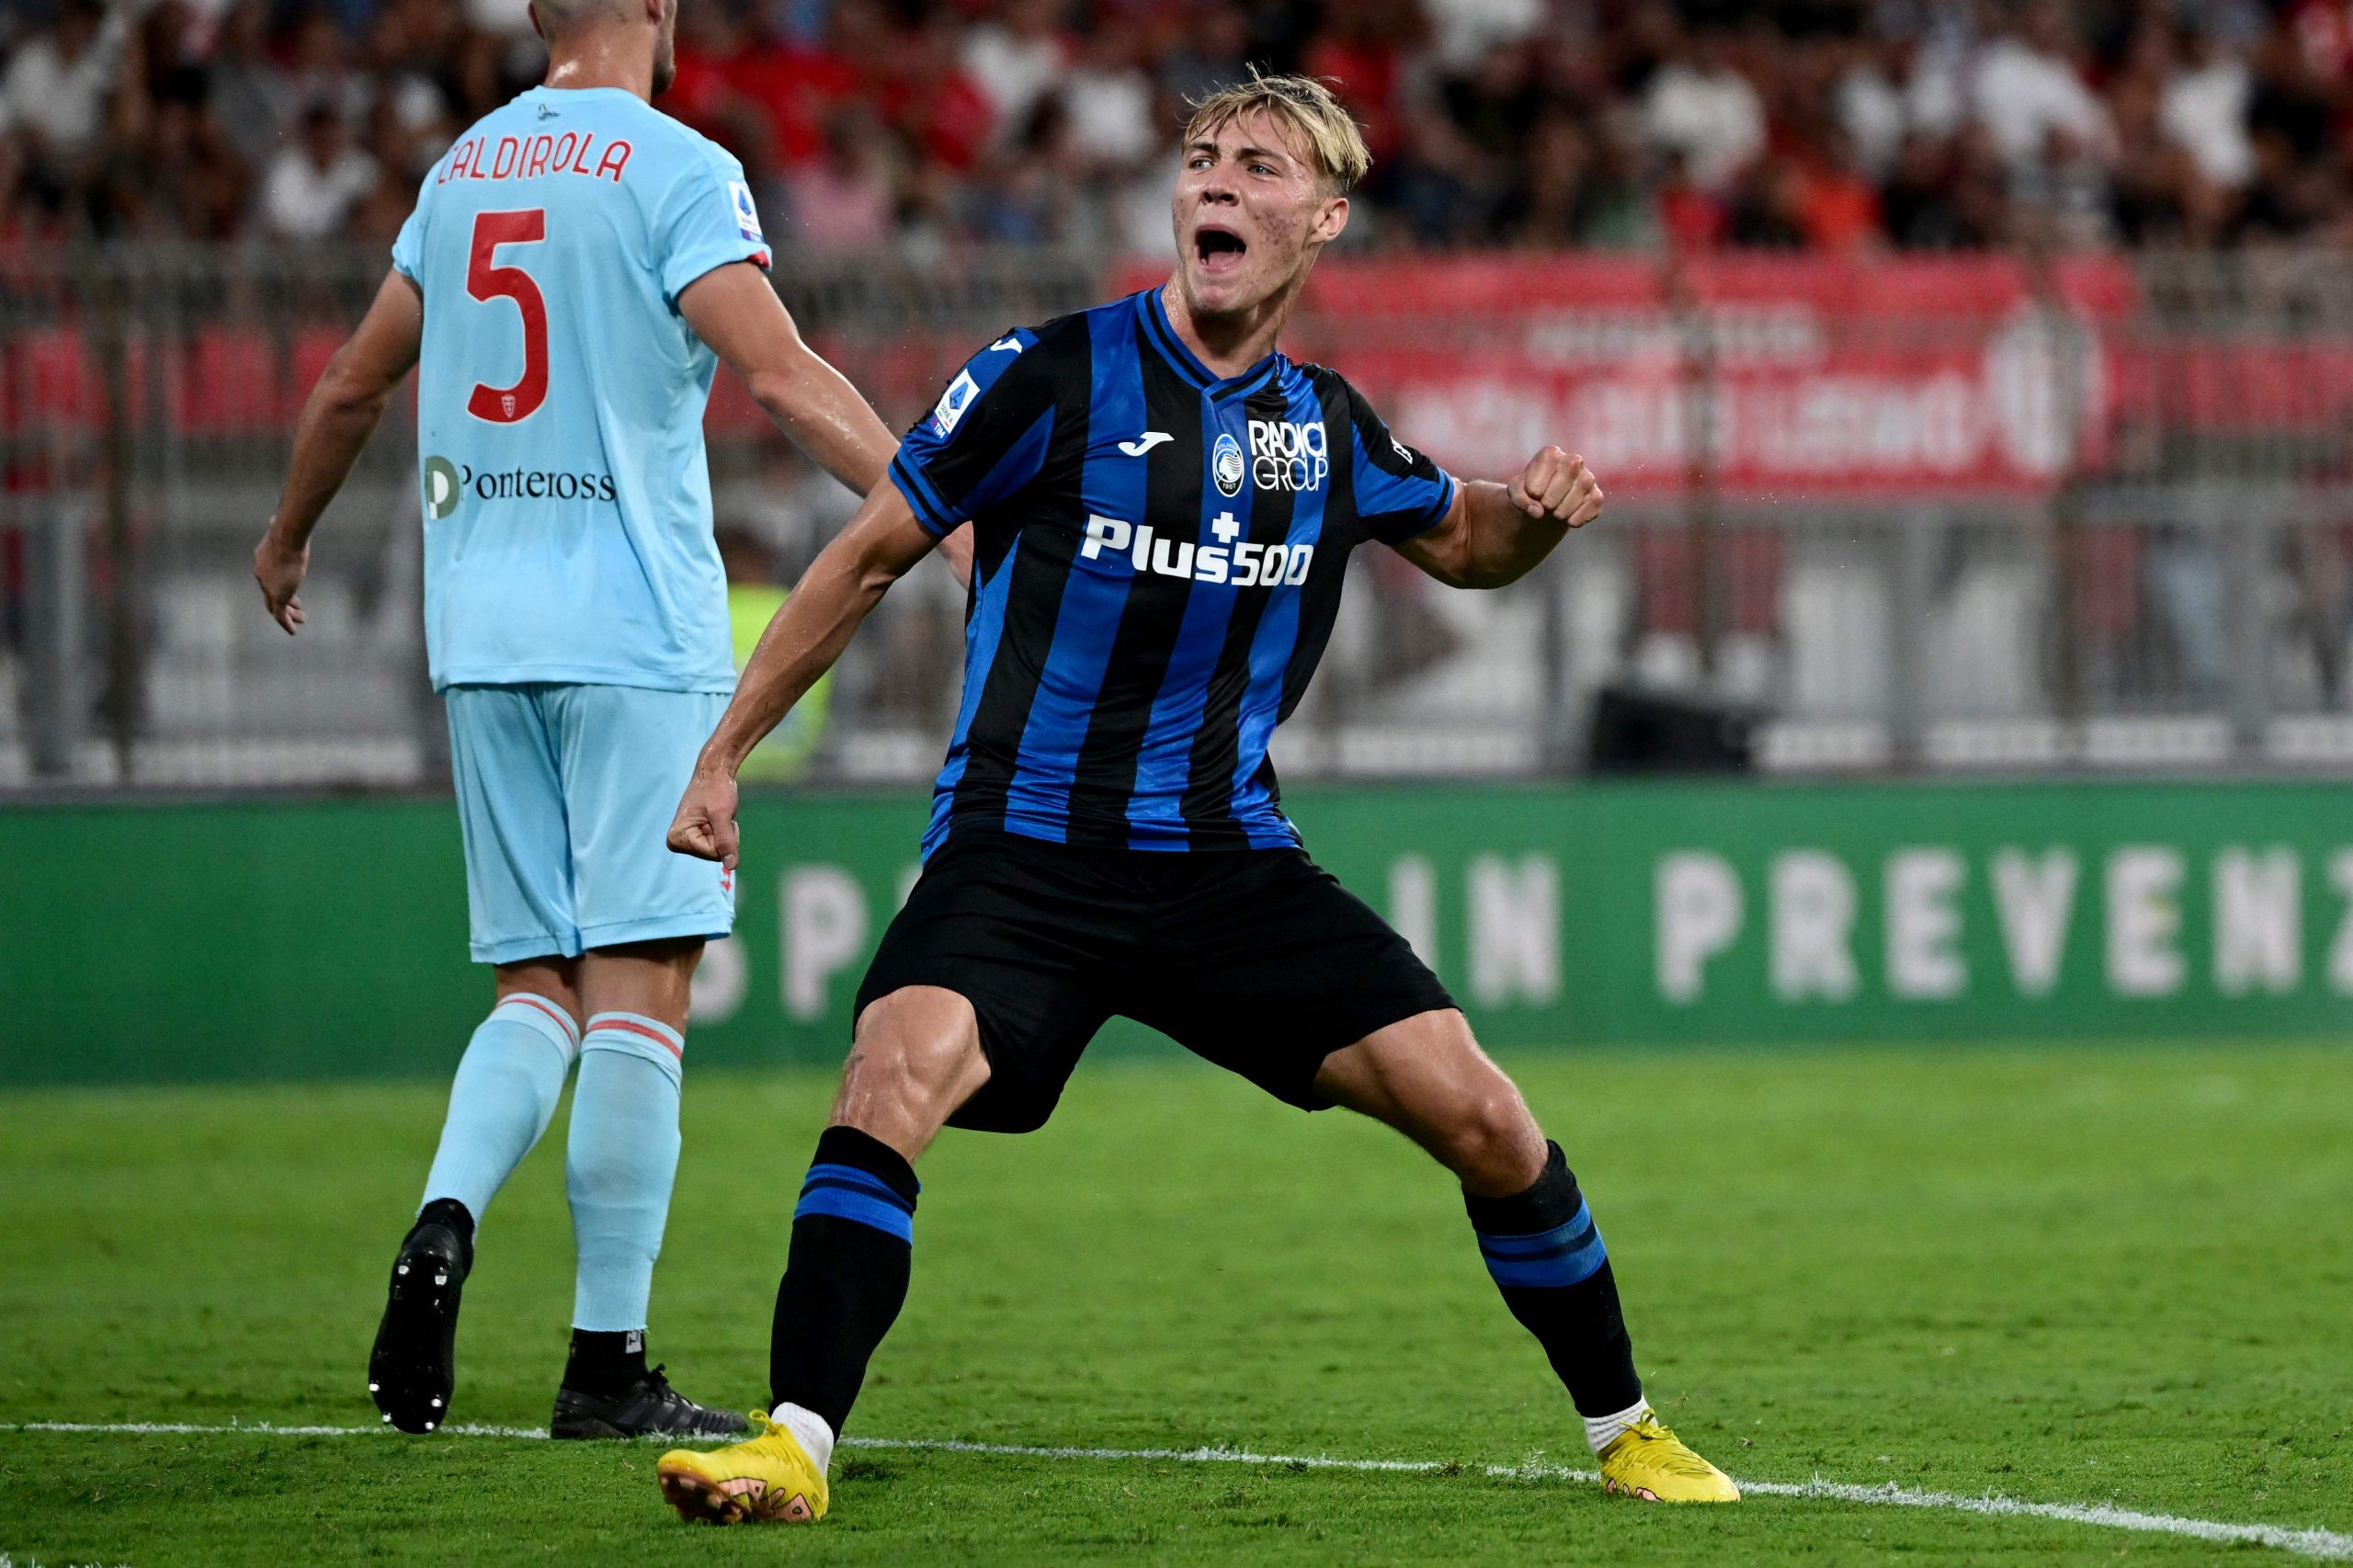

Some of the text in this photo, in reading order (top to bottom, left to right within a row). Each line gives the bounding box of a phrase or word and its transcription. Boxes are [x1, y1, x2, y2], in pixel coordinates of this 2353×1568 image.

[466, 209, 549, 424] 5
[1248, 420, 1327, 458] RADICI
[1253, 456, 1328, 492] GROUP
[1080, 513, 1313, 586] Plus500
